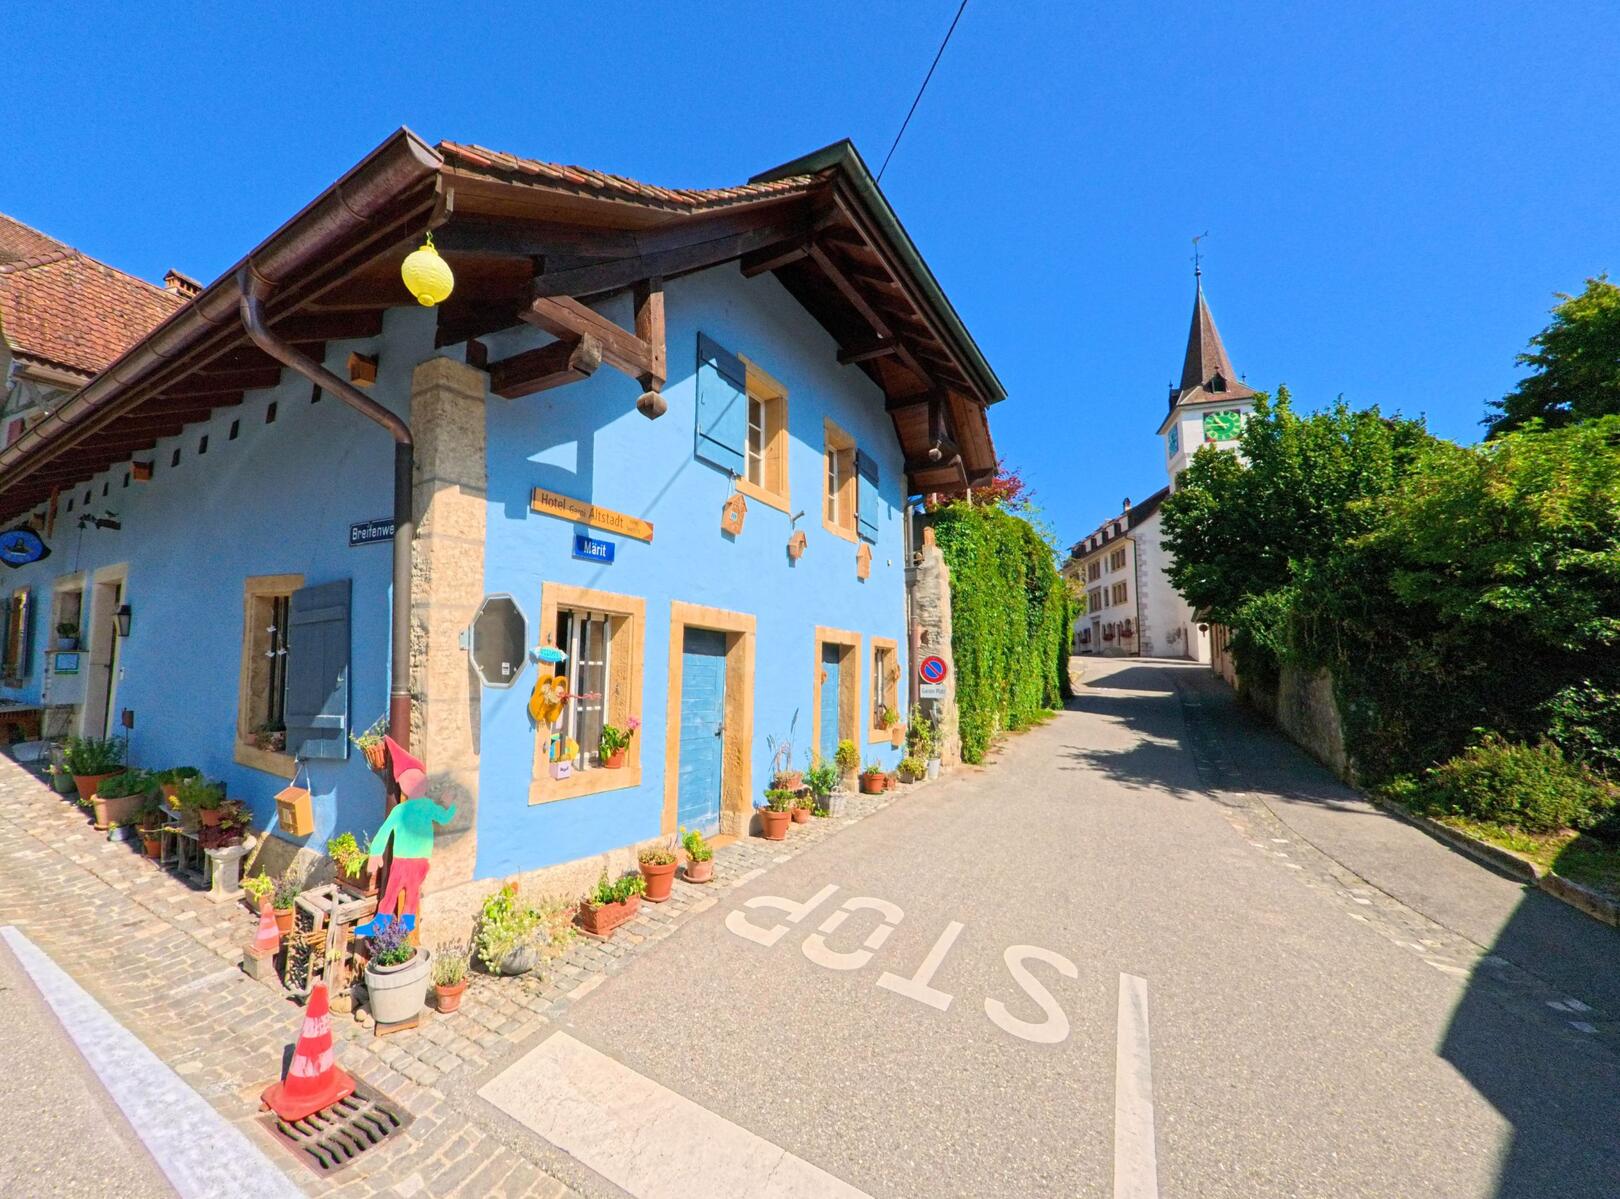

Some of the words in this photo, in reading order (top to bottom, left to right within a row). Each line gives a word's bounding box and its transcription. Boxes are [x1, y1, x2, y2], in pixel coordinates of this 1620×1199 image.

[541, 492, 566, 510] Hotel
[588, 507, 624, 528] Altstadt
[352, 524, 395, 540] Breitenwe
[584, 540, 606, 557] Märit
[725, 884, 1078, 1044] STOP
